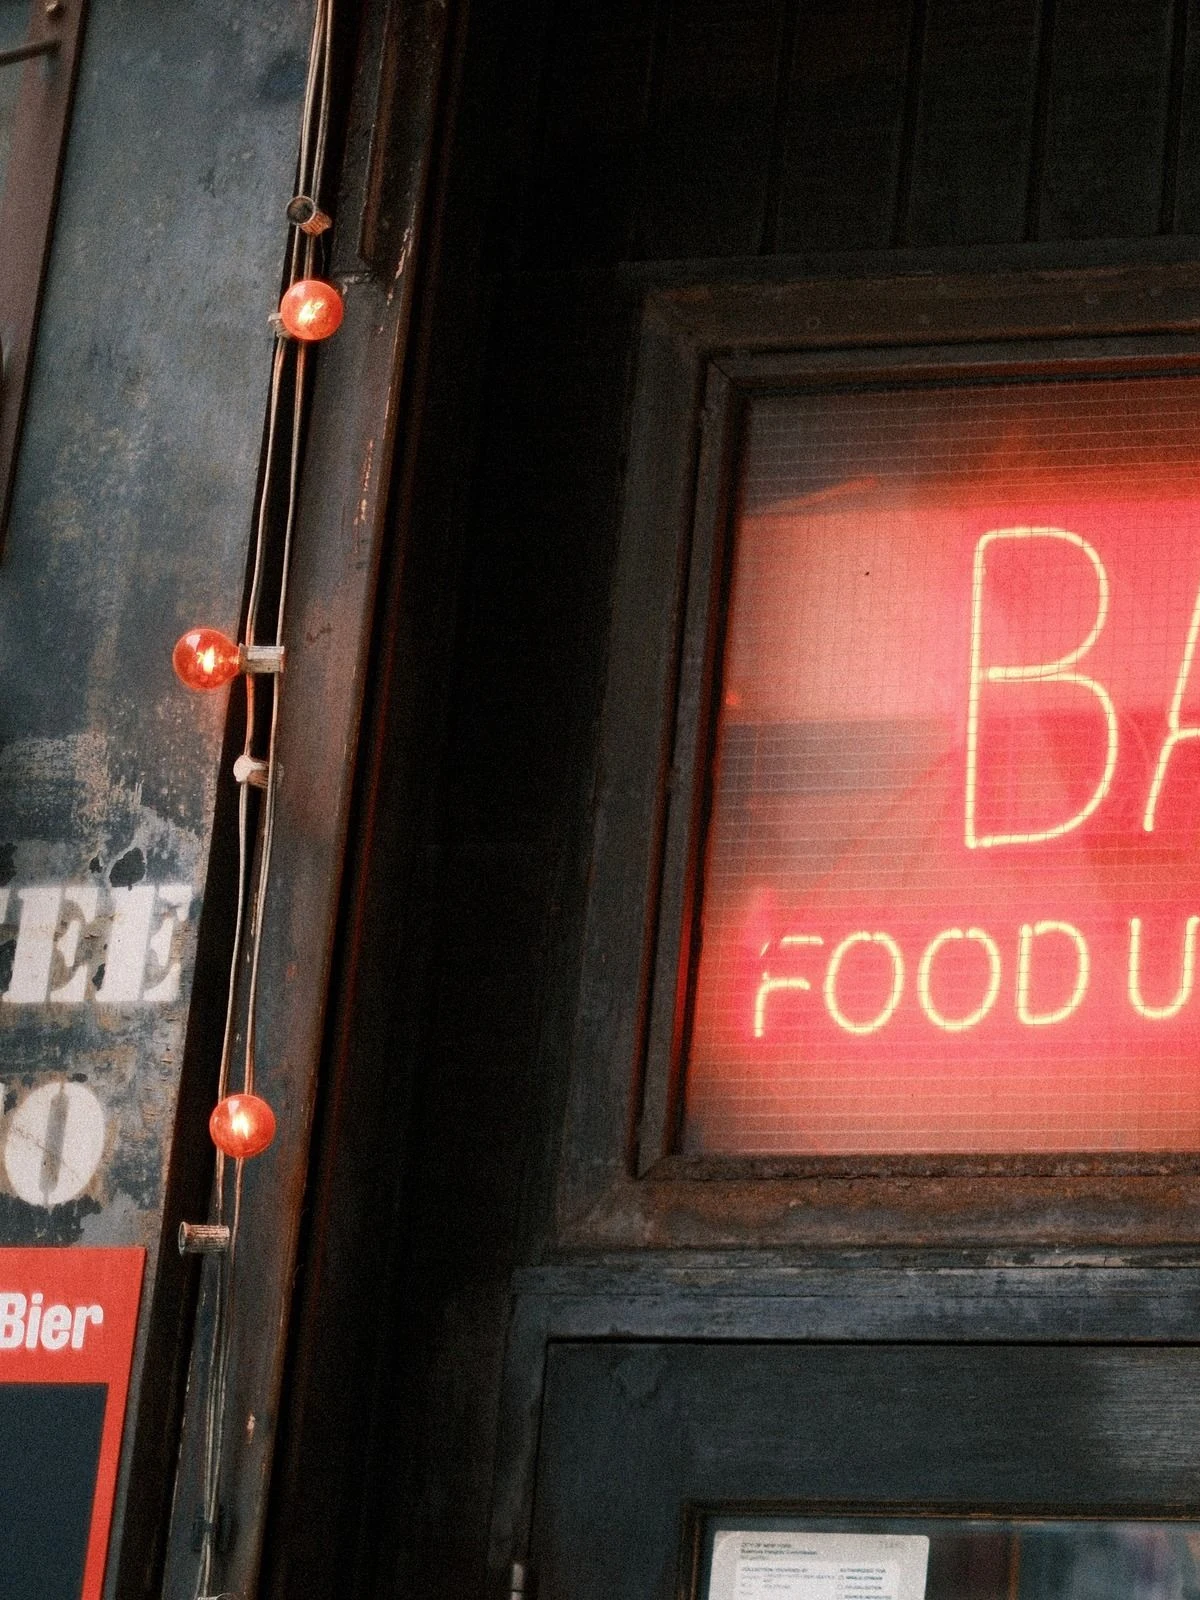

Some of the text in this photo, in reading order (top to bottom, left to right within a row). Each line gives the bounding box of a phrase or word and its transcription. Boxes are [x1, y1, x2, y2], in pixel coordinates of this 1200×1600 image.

[0, 886, 194, 1003] EE
[752, 919, 1090, 1038] FOOD
[0, 1291, 104, 1351] Bier
